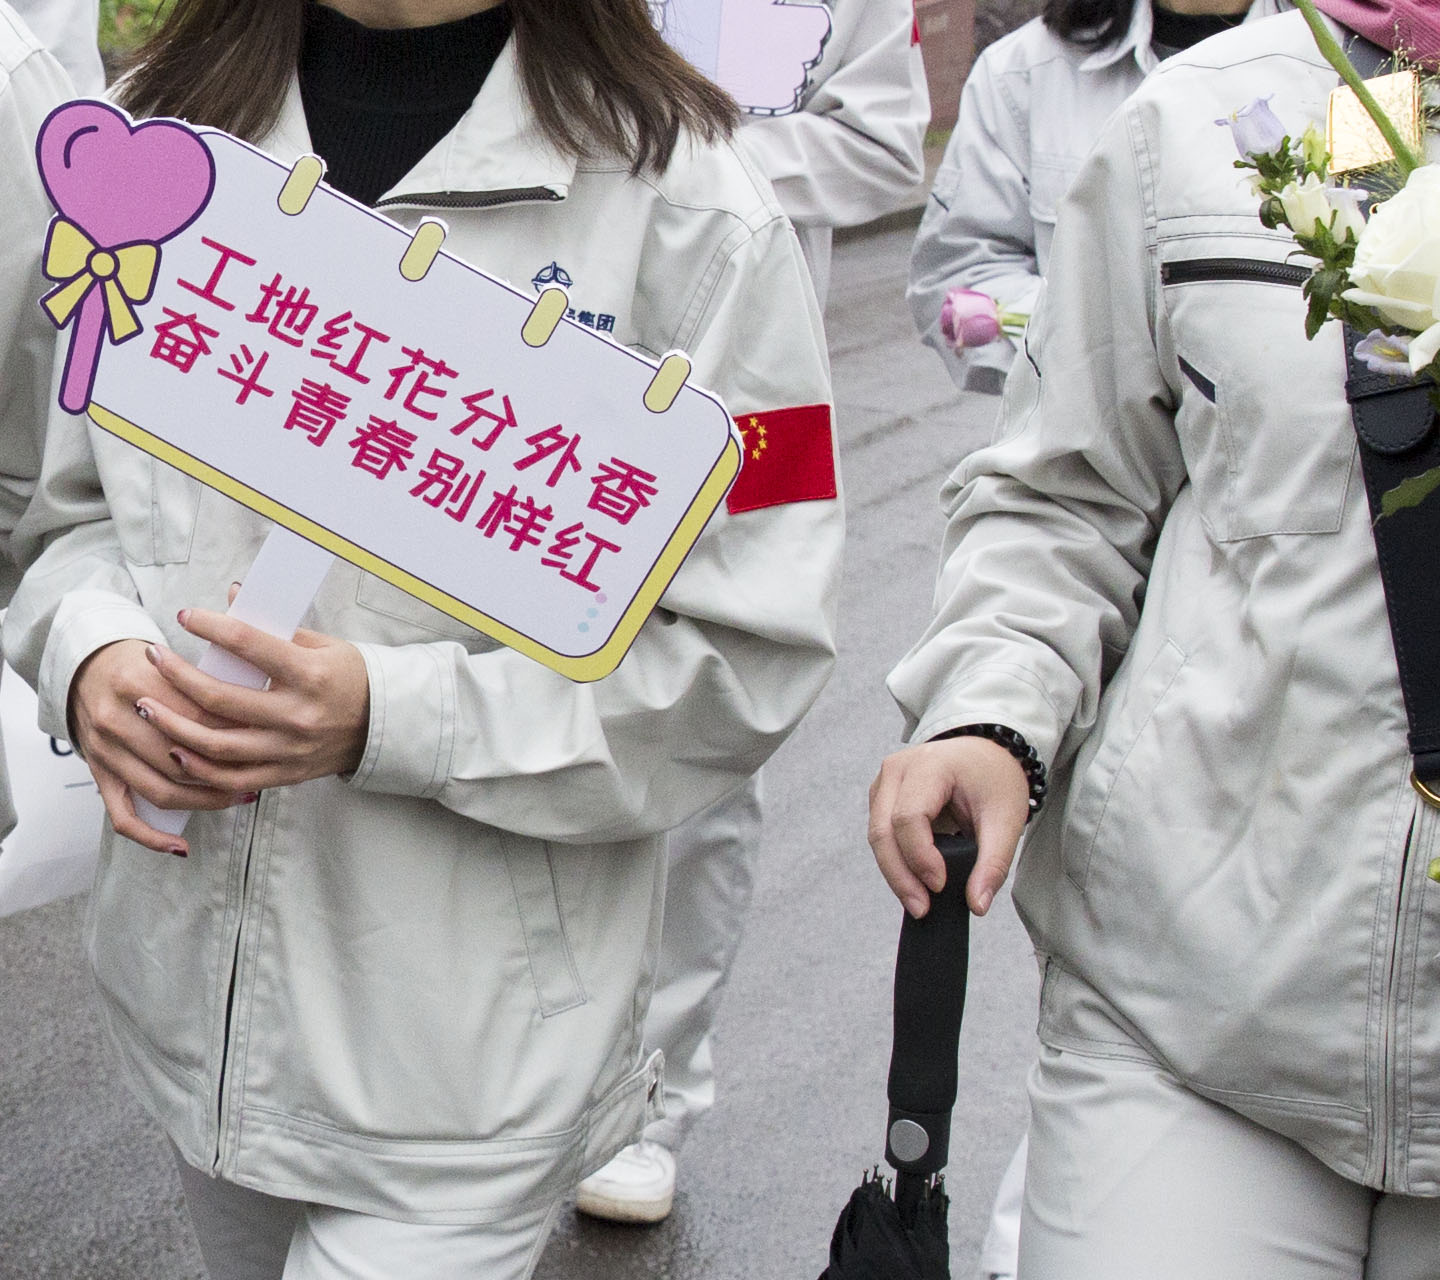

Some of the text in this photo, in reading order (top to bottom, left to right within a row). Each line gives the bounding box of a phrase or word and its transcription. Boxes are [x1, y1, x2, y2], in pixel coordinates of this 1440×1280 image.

[150, 308, 621, 593] 奋斗青春别样红
[177, 237, 657, 525] 工地红花分外香
